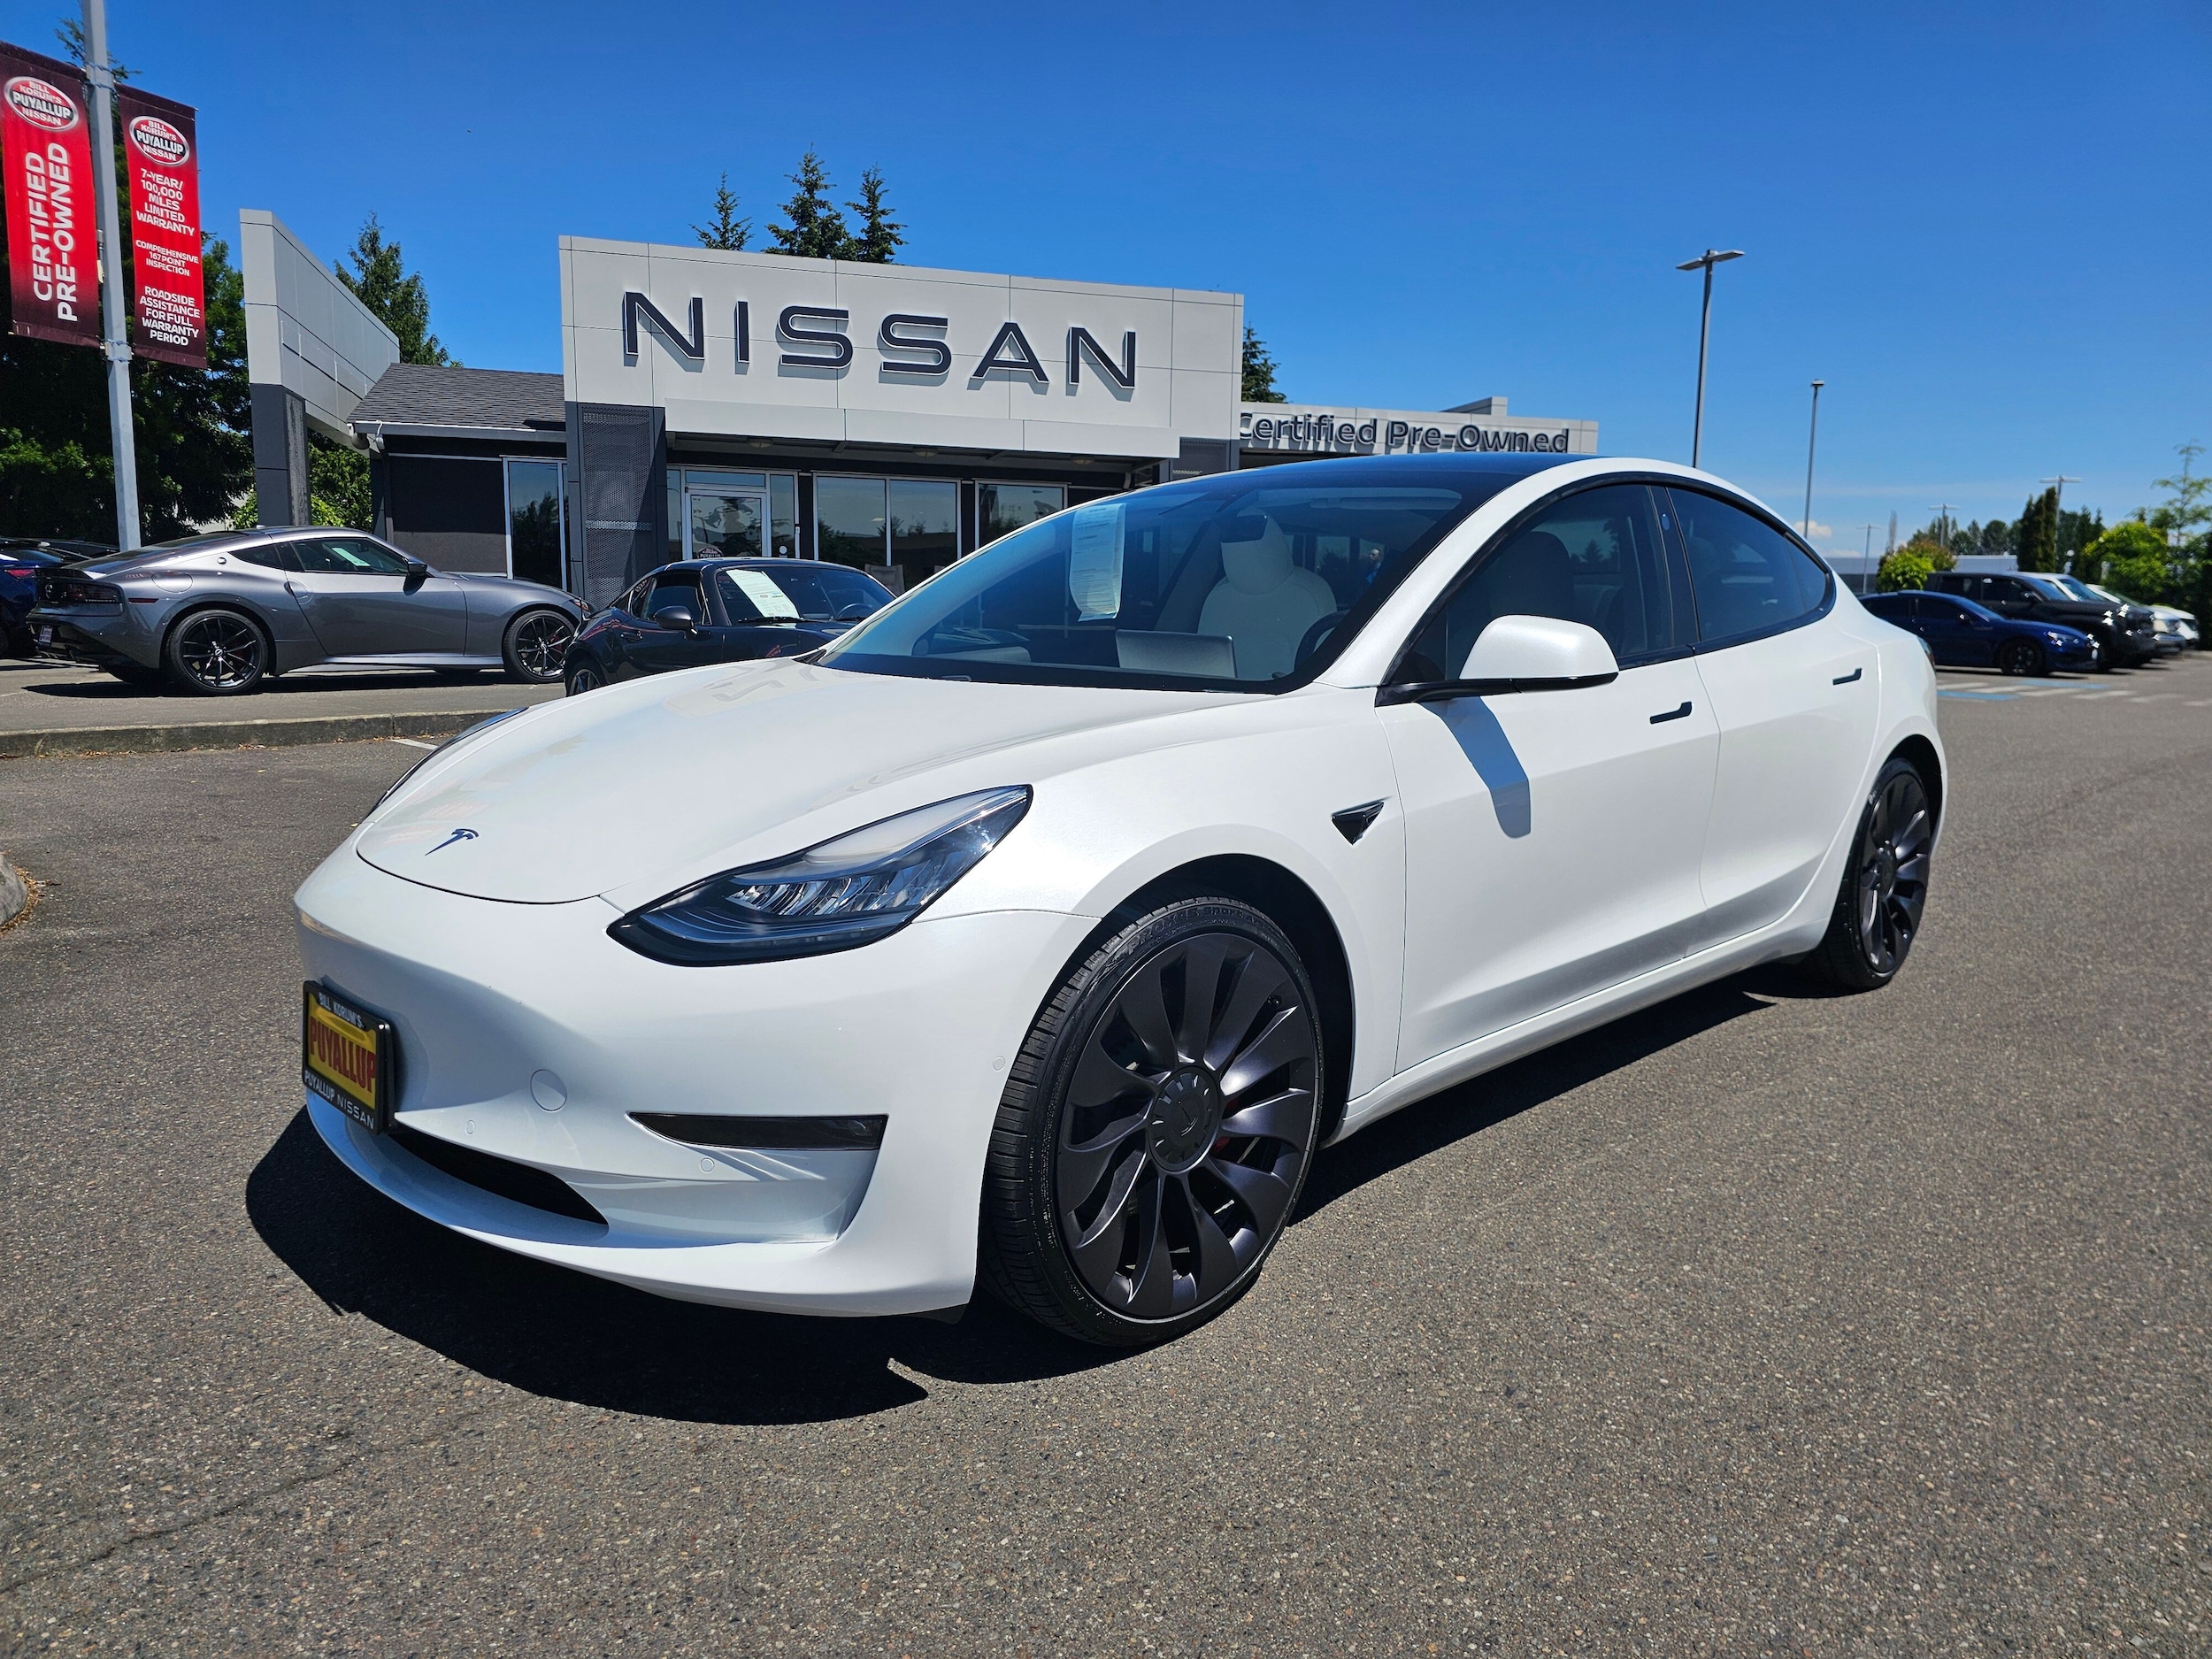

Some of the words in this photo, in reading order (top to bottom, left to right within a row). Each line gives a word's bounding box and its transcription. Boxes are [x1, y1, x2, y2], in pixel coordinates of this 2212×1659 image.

[19, 85, 63, 104] KORUM'S
[29, 81, 50, 94] BILL
[12, 91, 71, 119] PUYALLUP
[22, 106, 62, 126] NISSAN
[148, 120, 166, 132] BILL
[136, 129, 184, 154] PUYALLUP
[141, 124, 177, 142] KORUM'S
[142, 144, 176, 161] NISSAN
[141, 168, 184, 191] 7-YEAR/
[141, 180, 183, 201] 100,000
[149, 192, 180, 211] MILES
[144, 202, 186, 223] LIMITED
[26, 151, 52, 302] CERTIFIED
[48, 142, 78, 322] PRE-OWNED
[136, 211, 195, 236] WARRANTY
[135, 239, 199, 264] COMPREHENSIVE
[149, 251, 162, 261] 167
[162, 256, 186, 268] POINT
[146, 258, 190, 276] INSPECTION
[144, 285, 196, 306] ROADSIDE
[139, 296, 200, 319] ASSISTANCE
[145, 308, 166, 321] FOR
[166, 313, 193, 327] FULL
[142, 317, 199, 338] WARRANTY
[150, 330, 189, 346] PERIOD
[623, 290, 1136, 391] NISSAN
[1389, 419, 1570, 454] Pre-Owned
[310, 1016, 377, 1094] PUYALLUP
[304, 1070, 335, 1100] PUYALLUP
[337, 1094, 375, 1130] NISSAN
